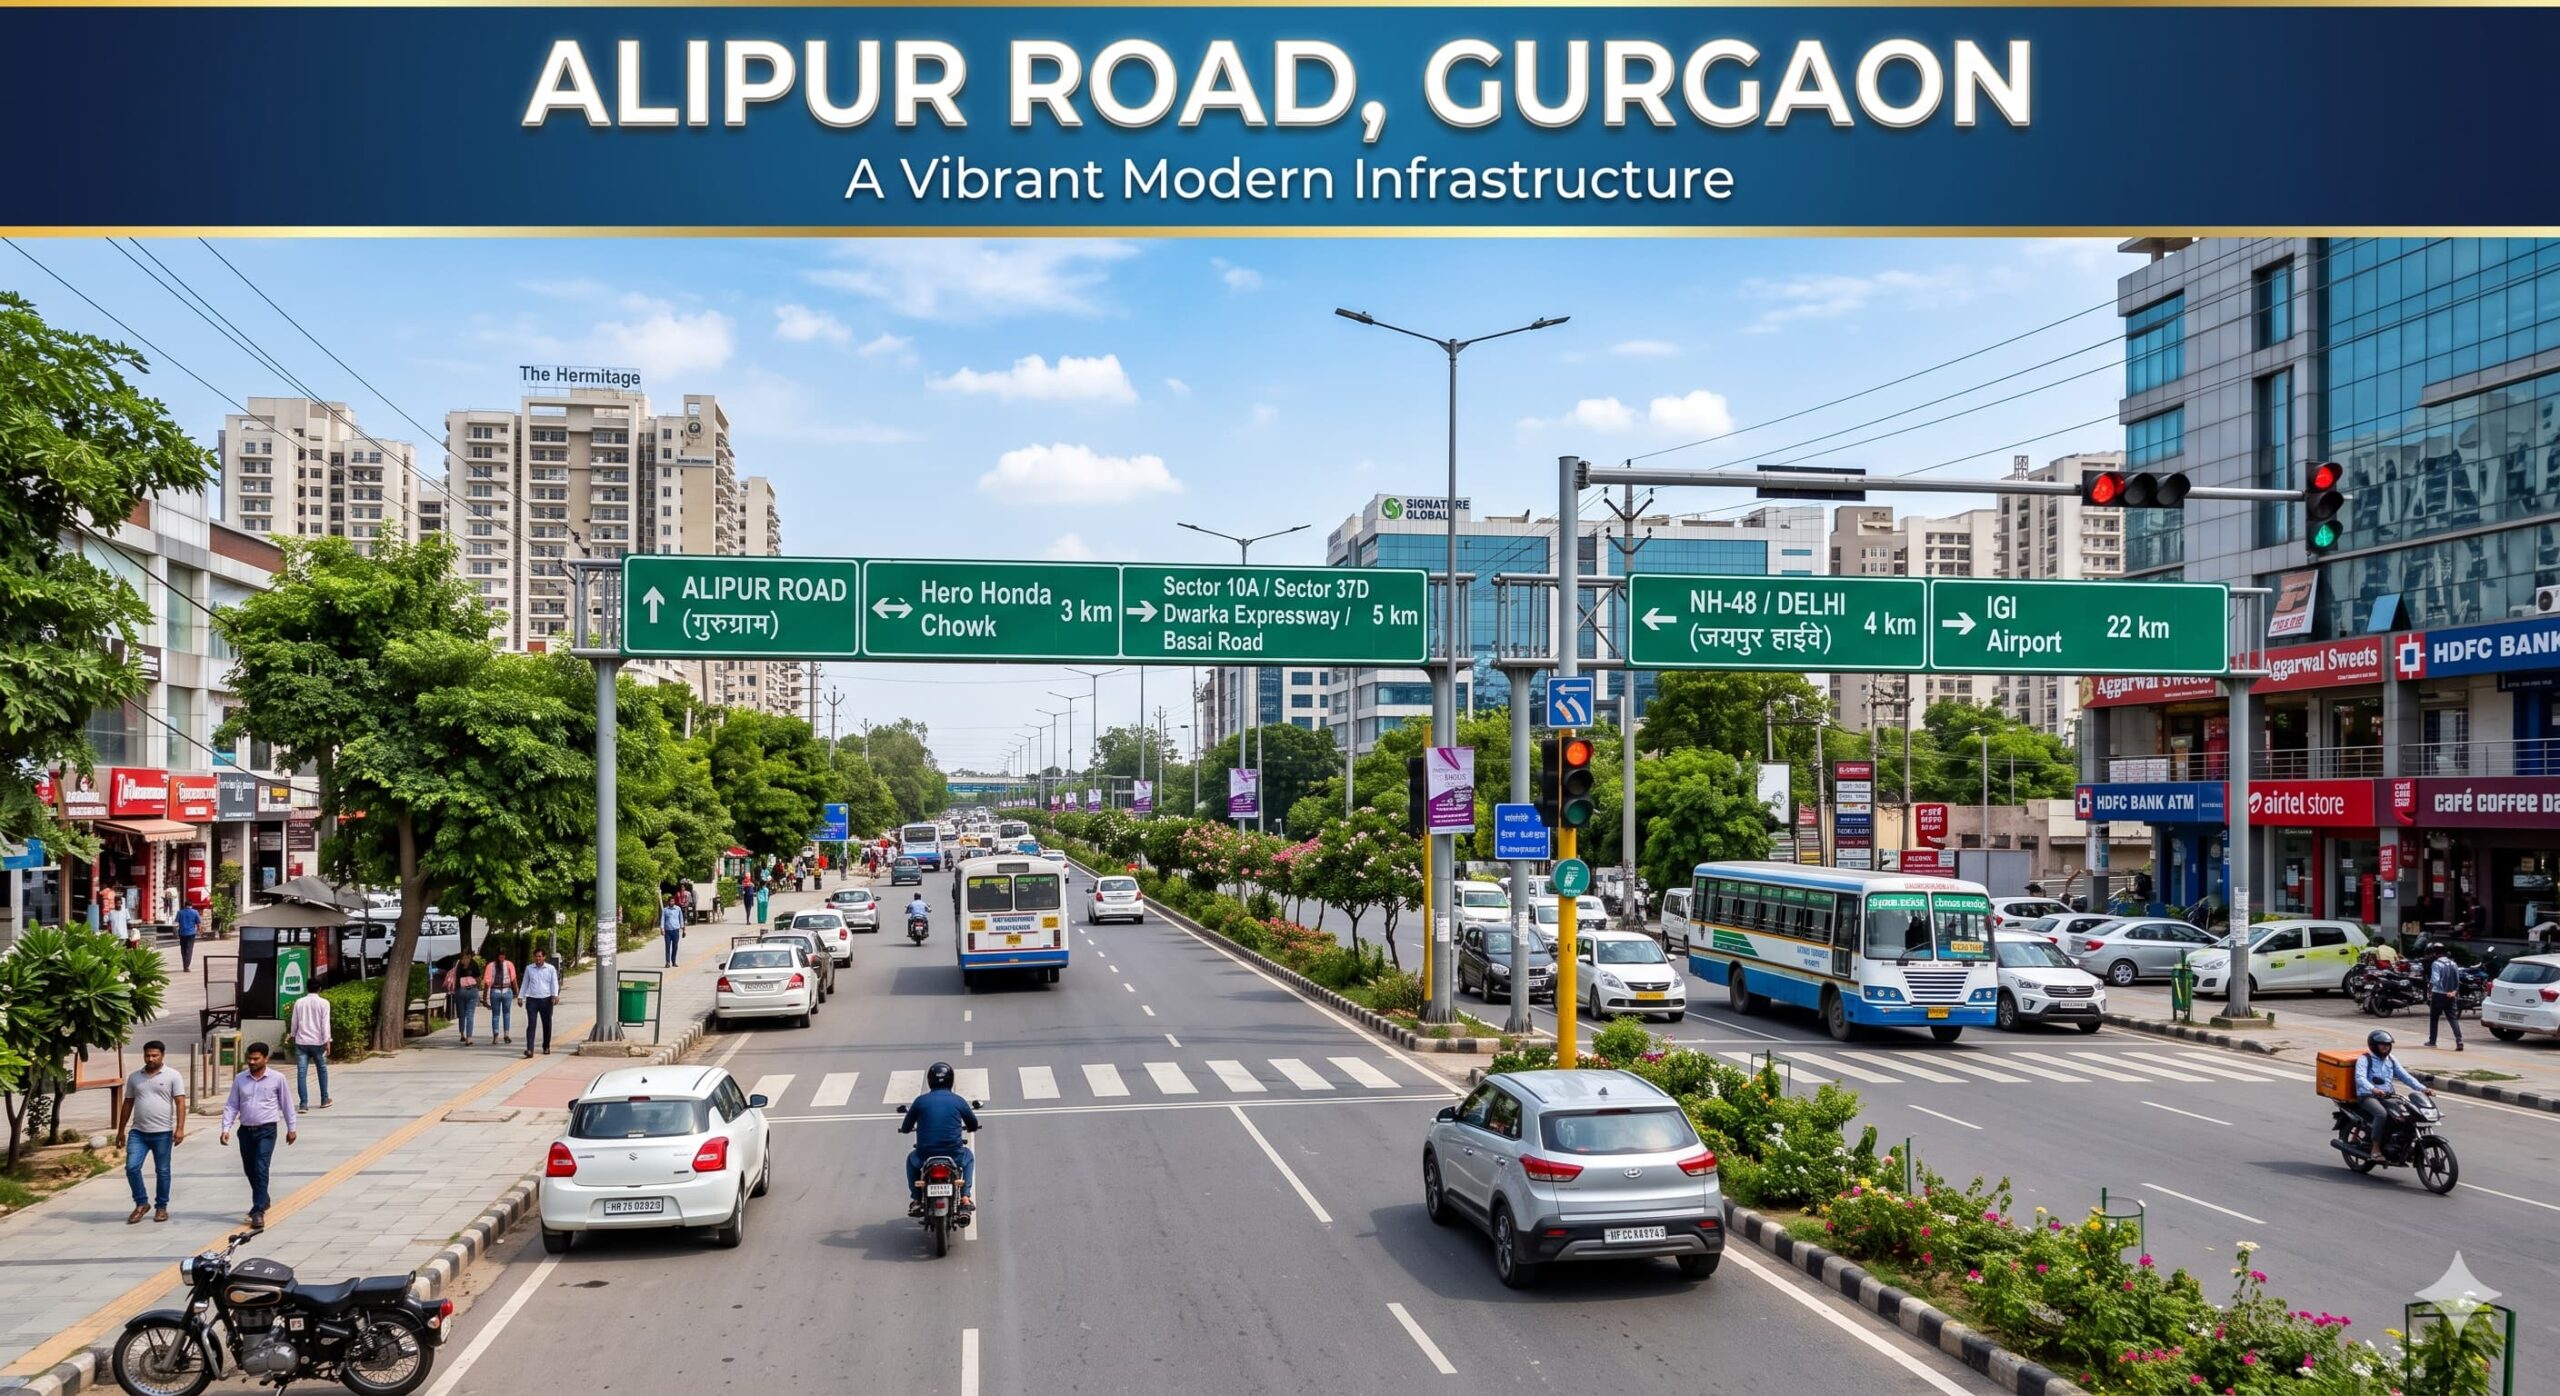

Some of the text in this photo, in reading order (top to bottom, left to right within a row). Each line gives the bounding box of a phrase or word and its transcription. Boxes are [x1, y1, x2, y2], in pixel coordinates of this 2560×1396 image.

[520, 366, 641, 389] The Hermitage
[682, 576, 847, 602] ALIPUR ROAD
[921, 580, 1052, 605] Hero Honda
[1163, 576, 1369, 599] Sector 10A / Sector 37D
[1060, 599, 1113, 622] 3 km
[1373, 605, 1418, 625] 5 km
[1690, 590, 1845, 616] NH-48 / DELHI
[1987, 595, 2016, 620] IGI
[682, 608, 779, 642] (गुरुग्राम)
[921, 614, 997, 637] Chowk
[1164, 603, 1351, 630] Dwarka Expressway /
[1864, 611, 1916, 635] 4 km
[2106, 615, 2170, 639] 22 km
[1164, 630, 1263, 651] Basai Road
[1690, 621, 1832, 656] (जयपुर हाईवे)
[1987, 629, 2062, 658] Airport
[2434, 631, 2560, 664] HDFC BANK
[2265, 646, 2378, 681] Aggarwal Sweets
[2097, 677, 2158, 699] Aggarwal
[2097, 795, 2128, 811] HDFC
[2130, 794, 2164, 810] BANK
[2167, 794, 2194, 810] ATM
[2264, 790, 2344, 816] airtel store
